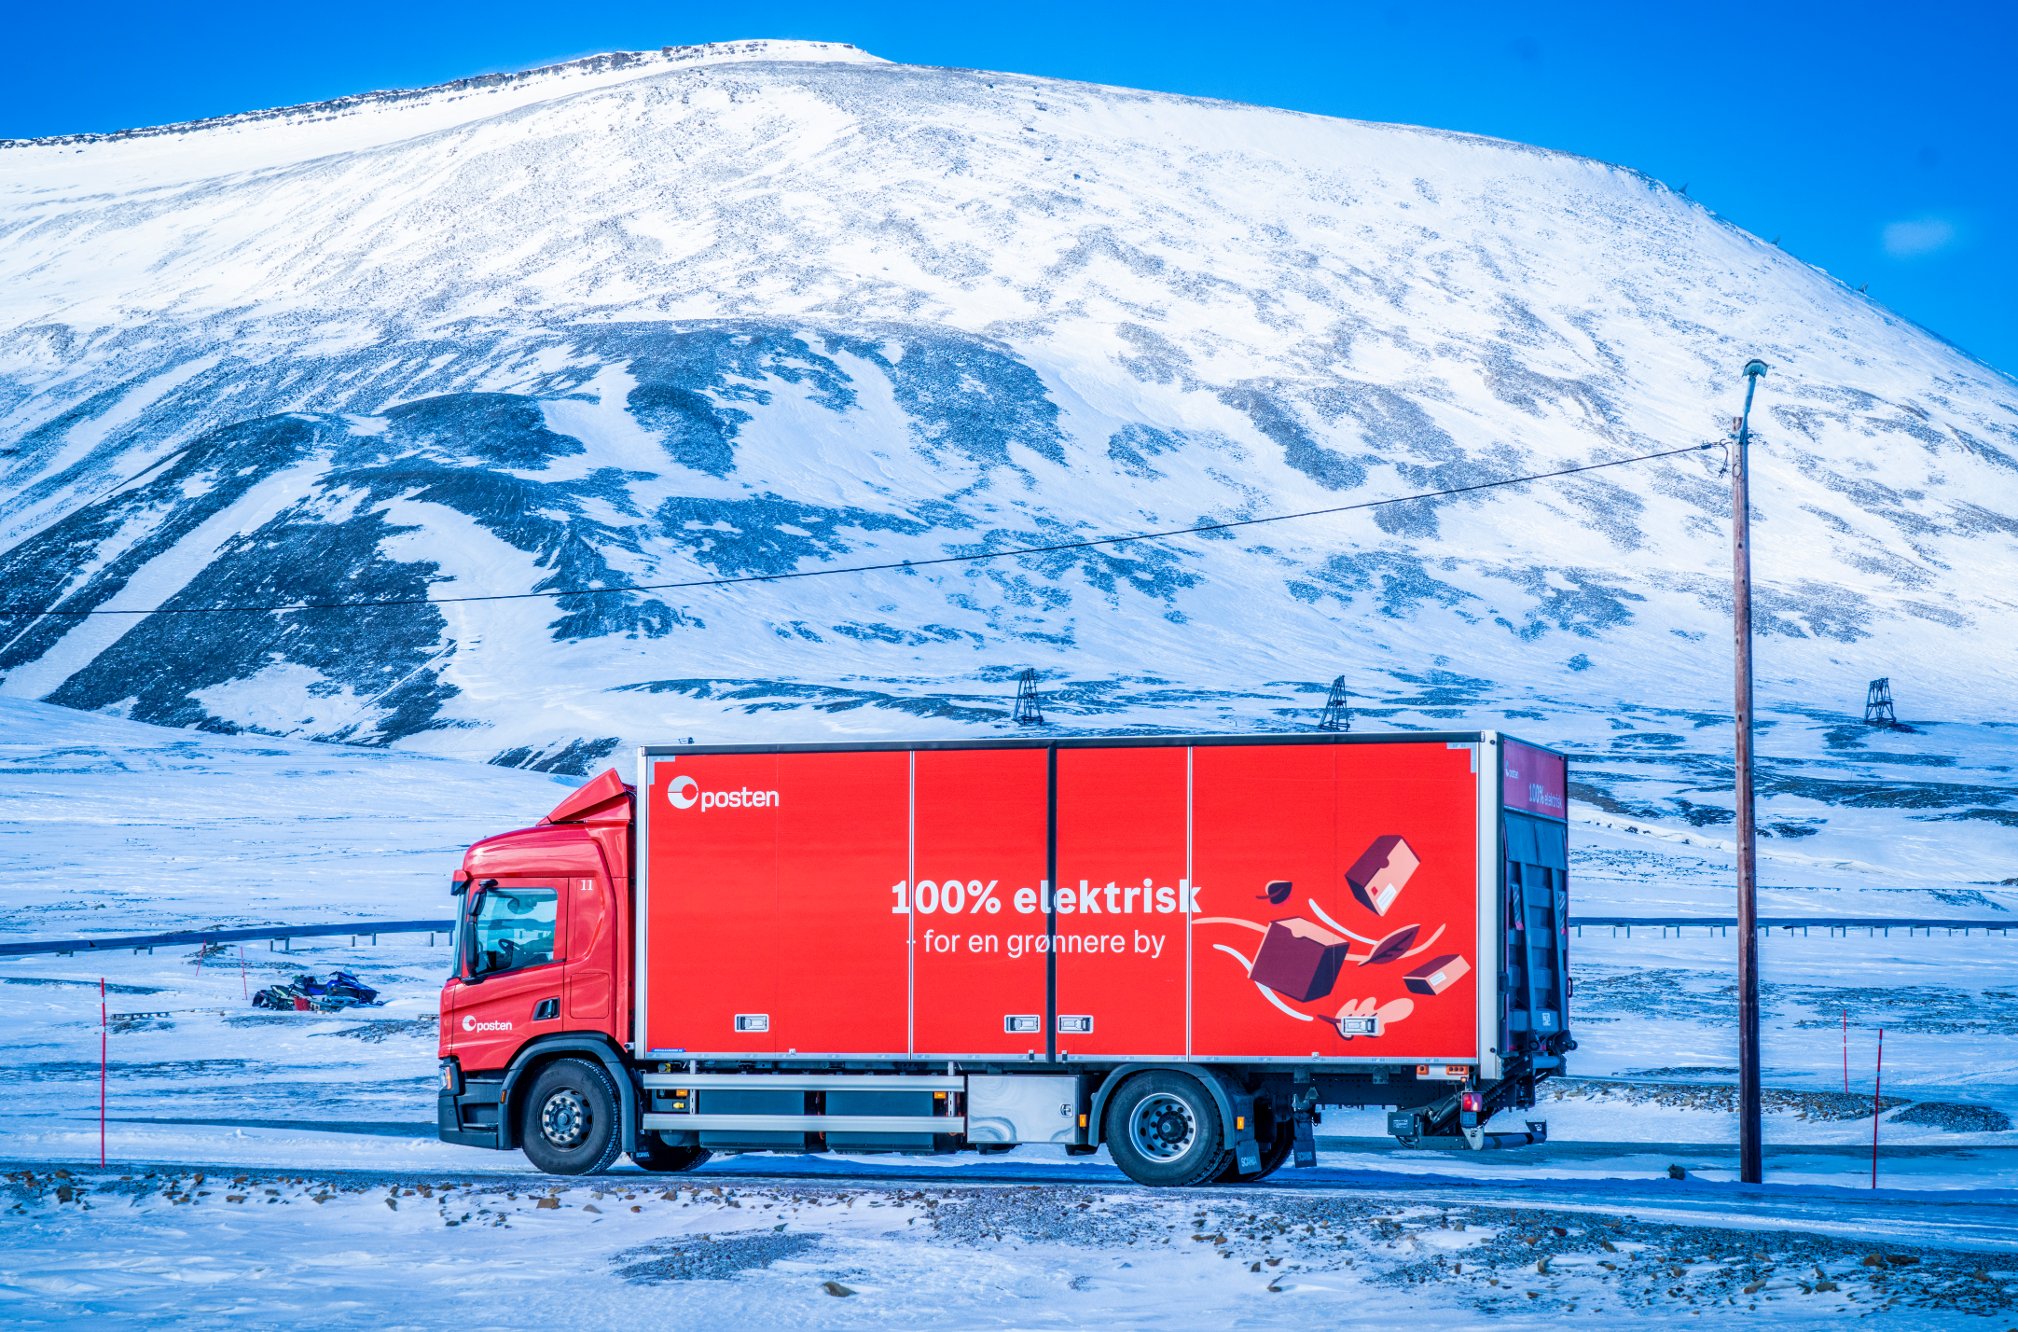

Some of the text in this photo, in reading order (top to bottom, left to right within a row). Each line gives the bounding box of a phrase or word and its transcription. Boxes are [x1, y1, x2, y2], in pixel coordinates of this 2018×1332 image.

[701, 786, 780, 813] posten
[580, 879, 593, 891] 11
[892, 878, 1203, 915] 100% elektrisk
[923, 929, 961, 953] for
[968, 934, 999, 953] en
[1007, 933, 1126, 959] grønnere
[1134, 929, 1166, 959] by
[476, 1020, 513, 1033] posten
